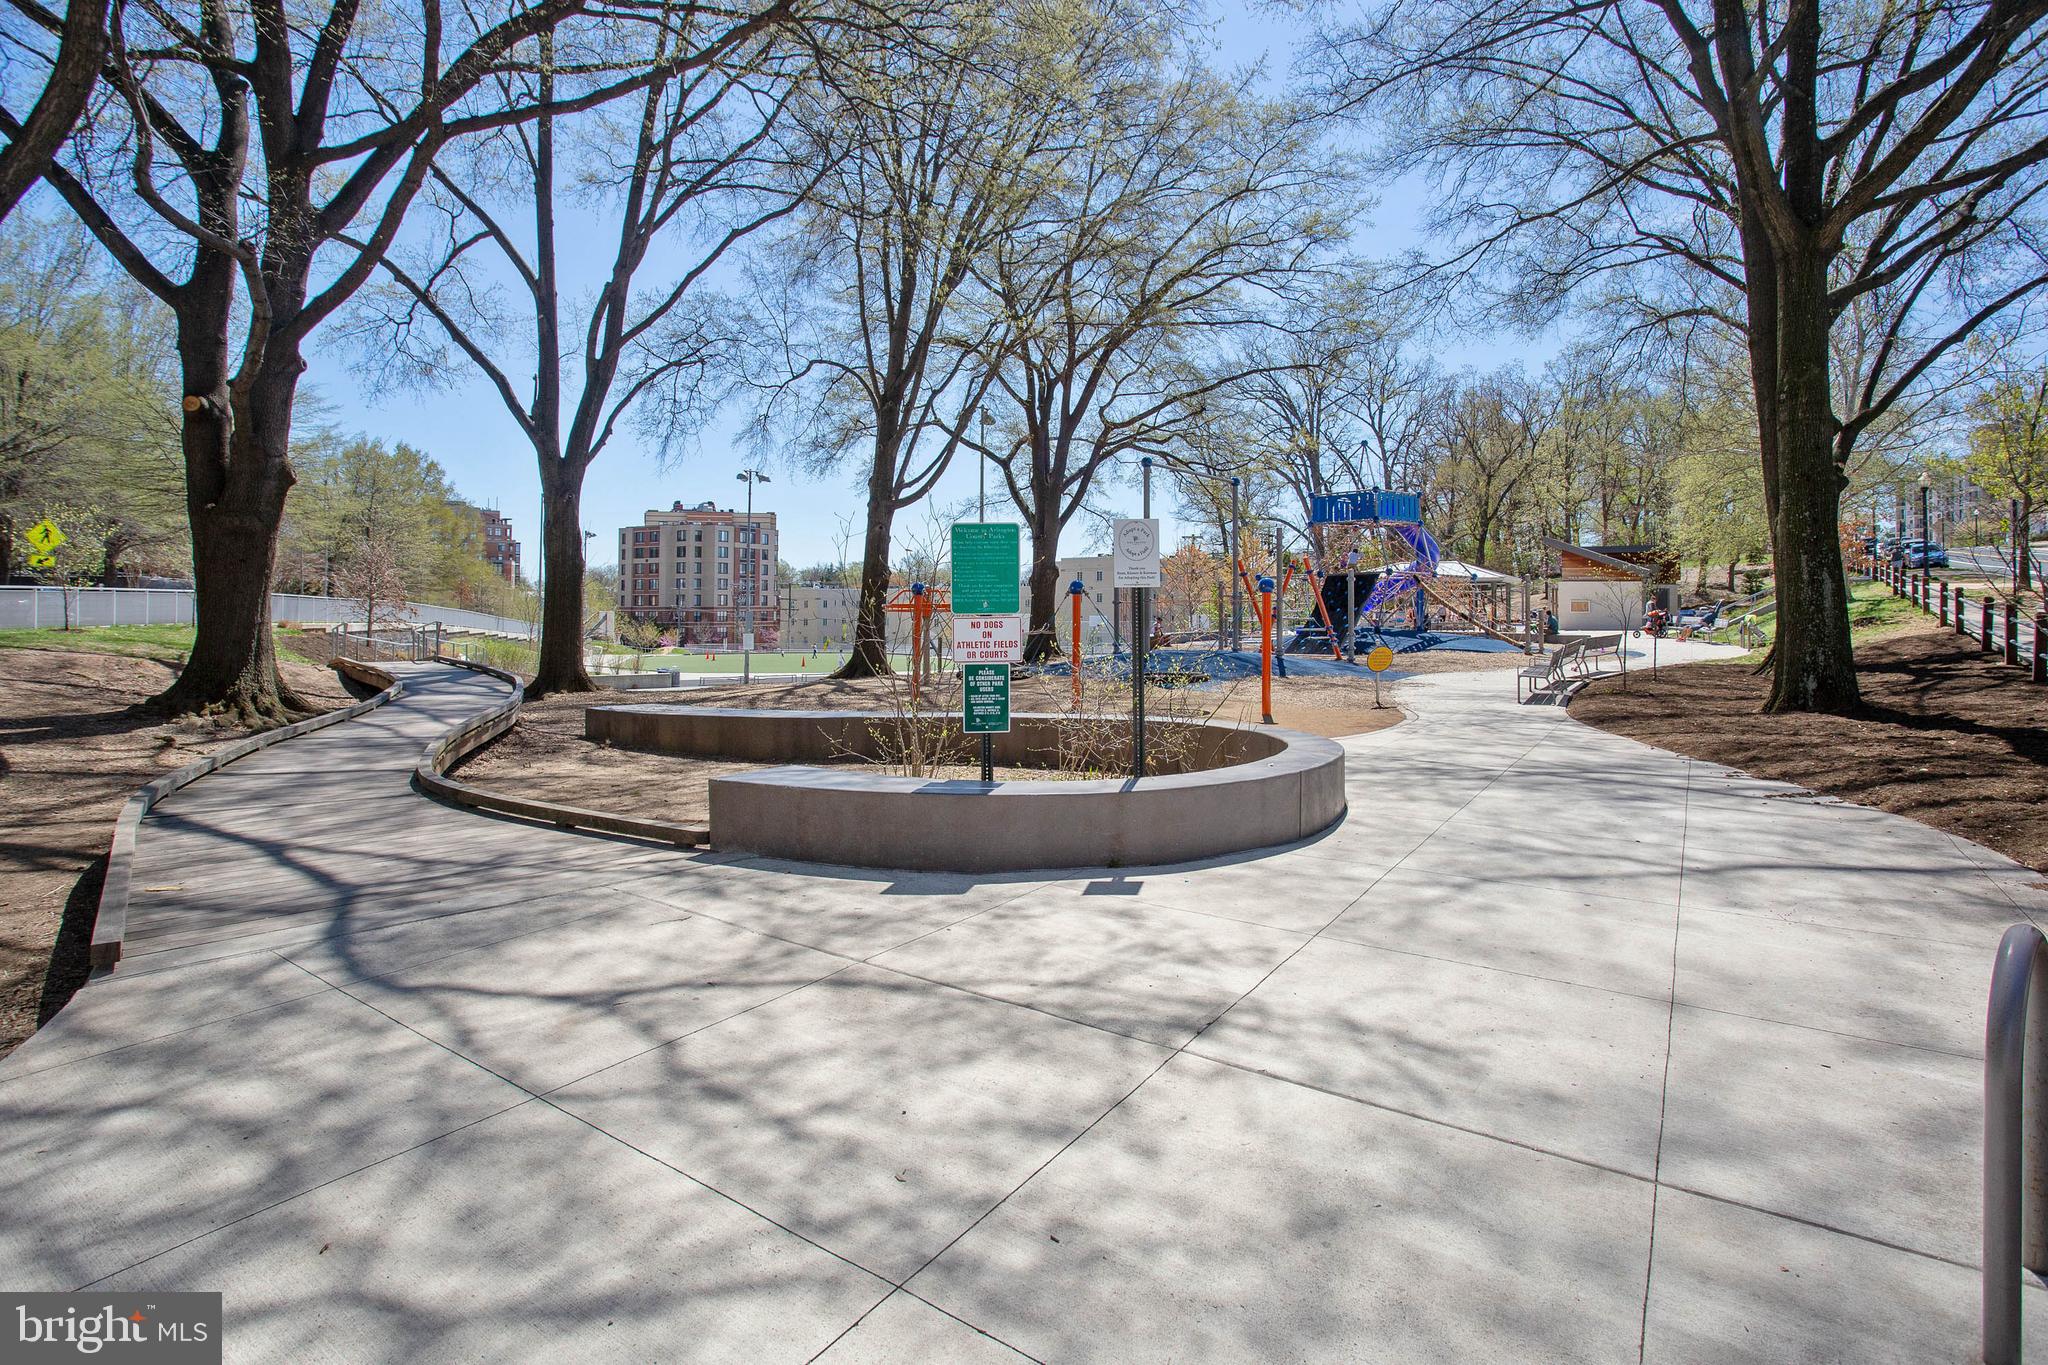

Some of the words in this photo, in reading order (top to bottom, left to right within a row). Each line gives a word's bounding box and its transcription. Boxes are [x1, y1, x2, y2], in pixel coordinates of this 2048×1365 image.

[970, 621, 981, 629] NO
[984, 620, 1004, 629] DOGS
[982, 631, 992, 639] ON
[957, 641, 991, 649] ATHLETIC
[993, 640, 1018, 648] FIELDS
[966, 651, 977, 659] OR
[980, 650, 1009, 659] COURTS
